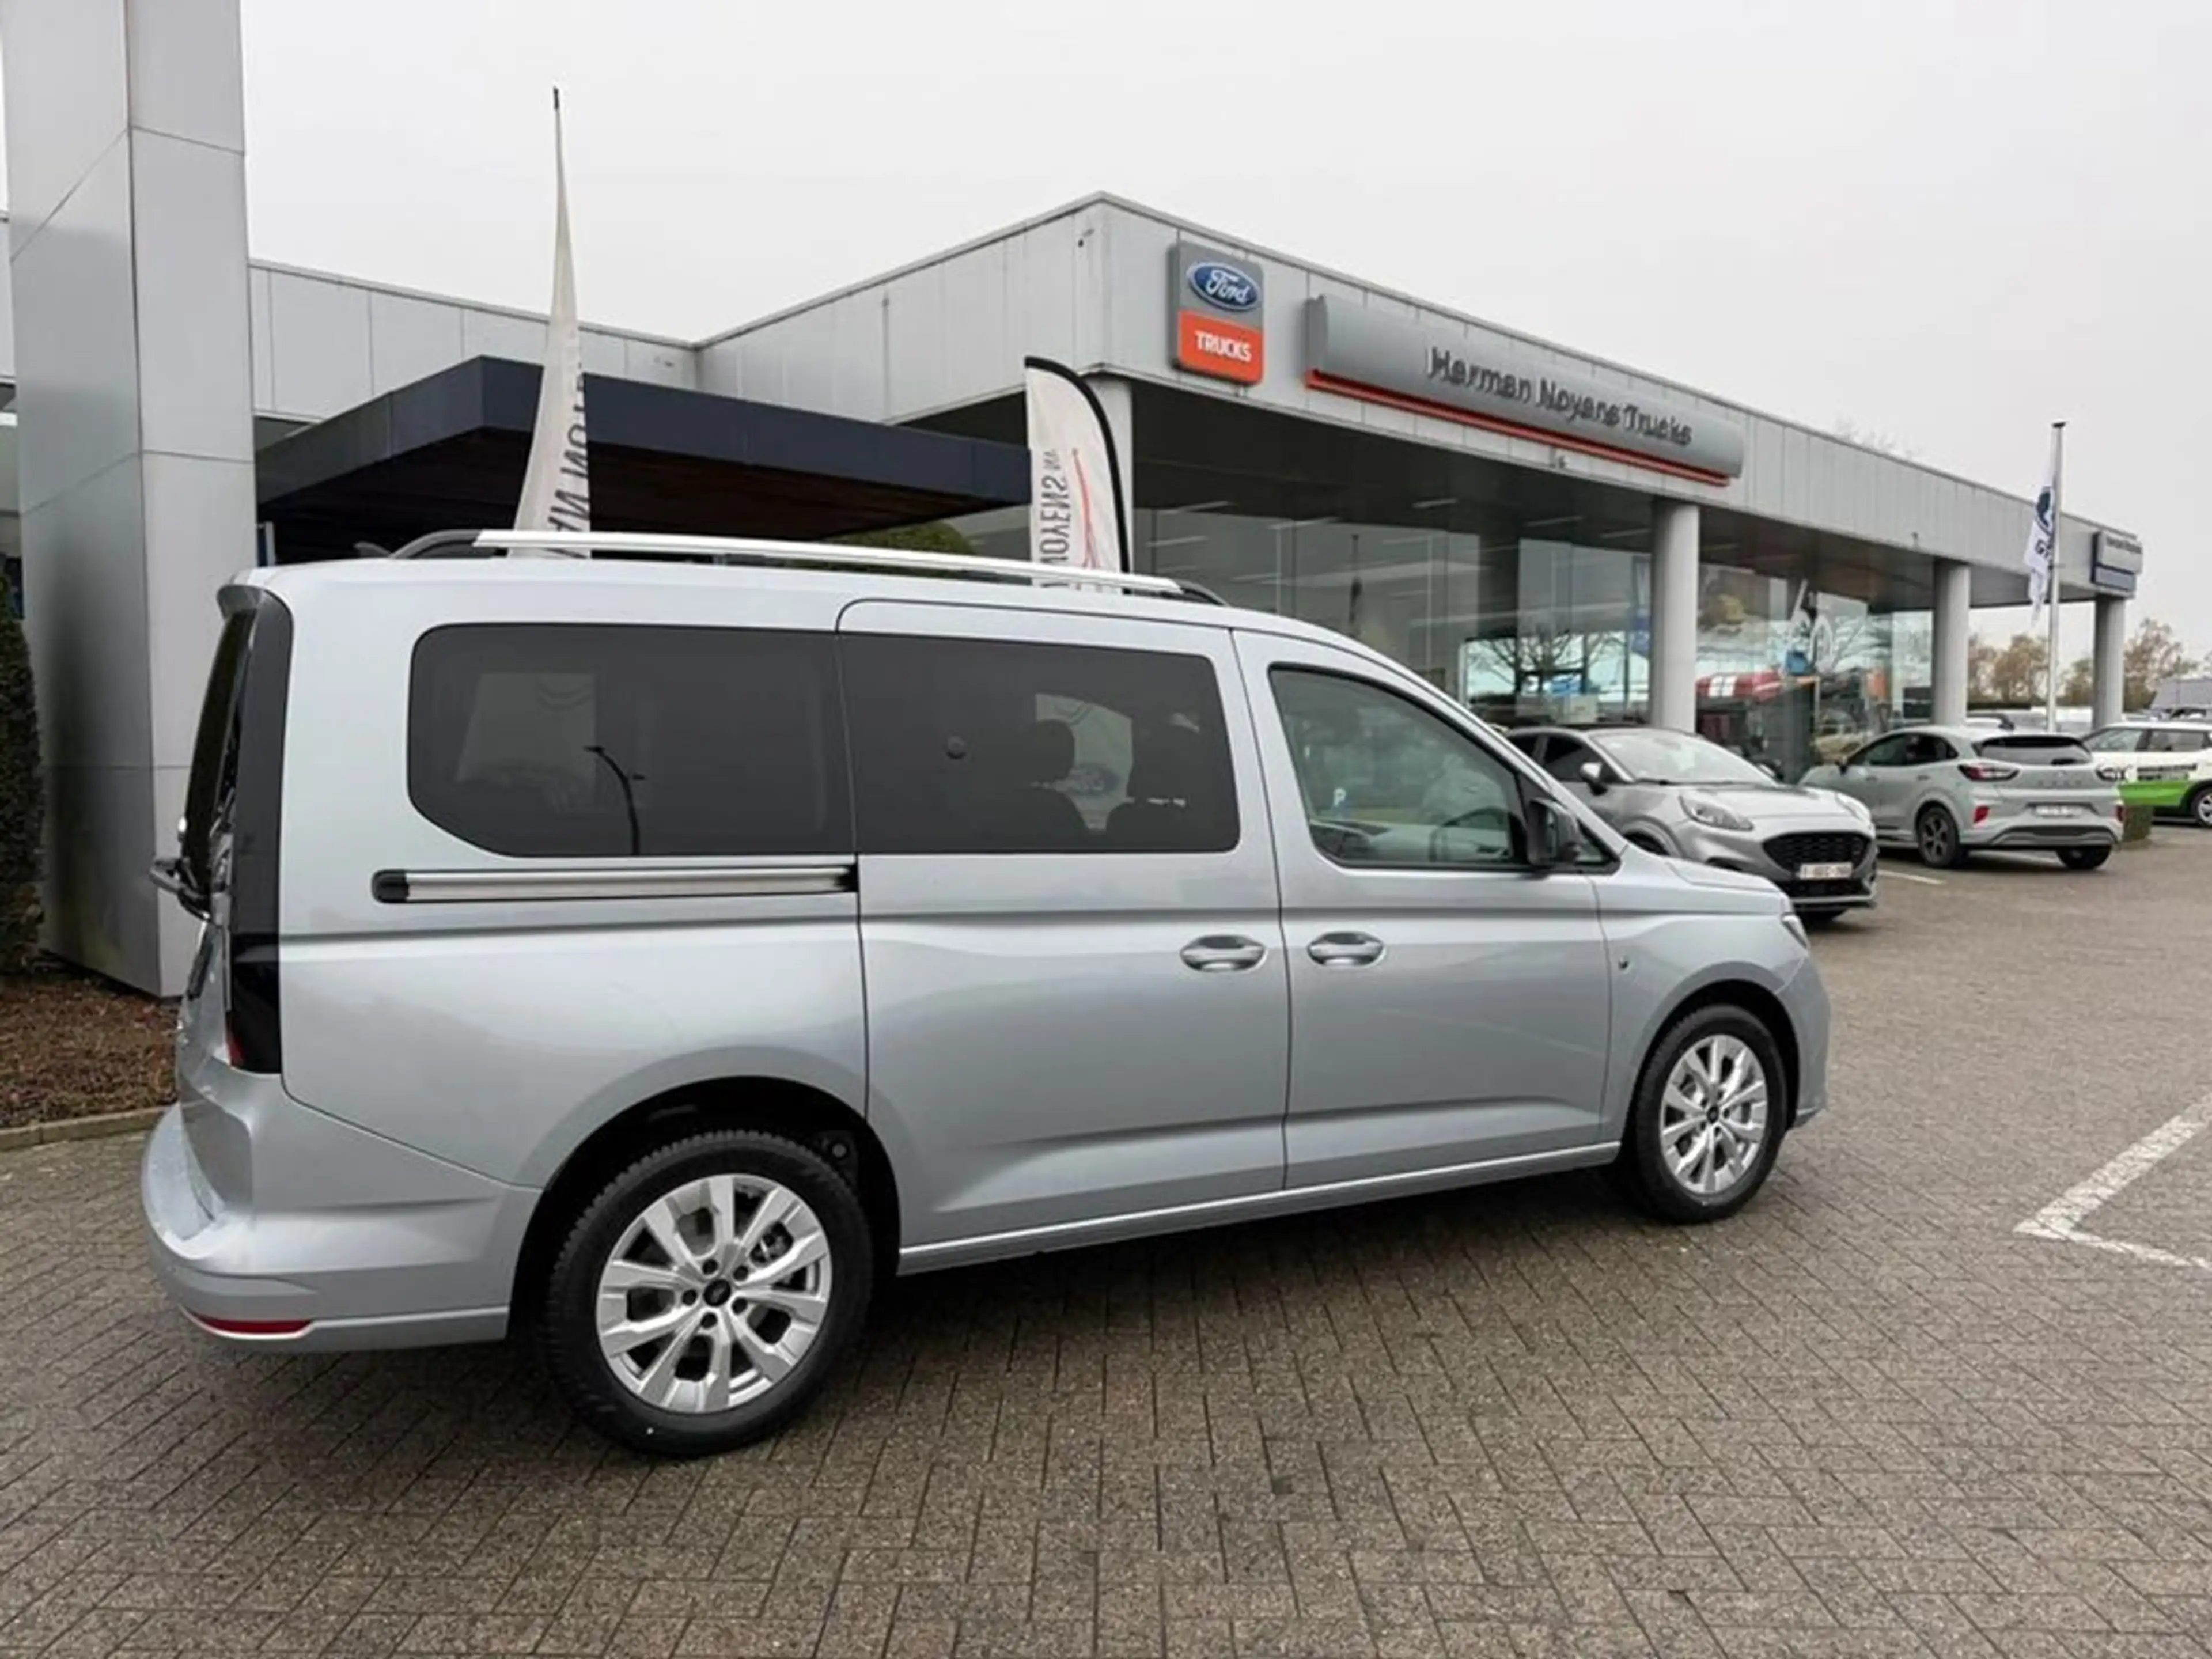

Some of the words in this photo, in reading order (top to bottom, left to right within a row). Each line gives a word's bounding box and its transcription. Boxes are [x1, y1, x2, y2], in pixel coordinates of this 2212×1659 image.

[1205, 269, 1251, 305] Ford
[1194, 329, 1252, 363] TRUCKS
[1429, 347, 1532, 403] Herman
[1539, 377, 1623, 427] Noyens
[1623, 404, 1693, 446] Trucks
